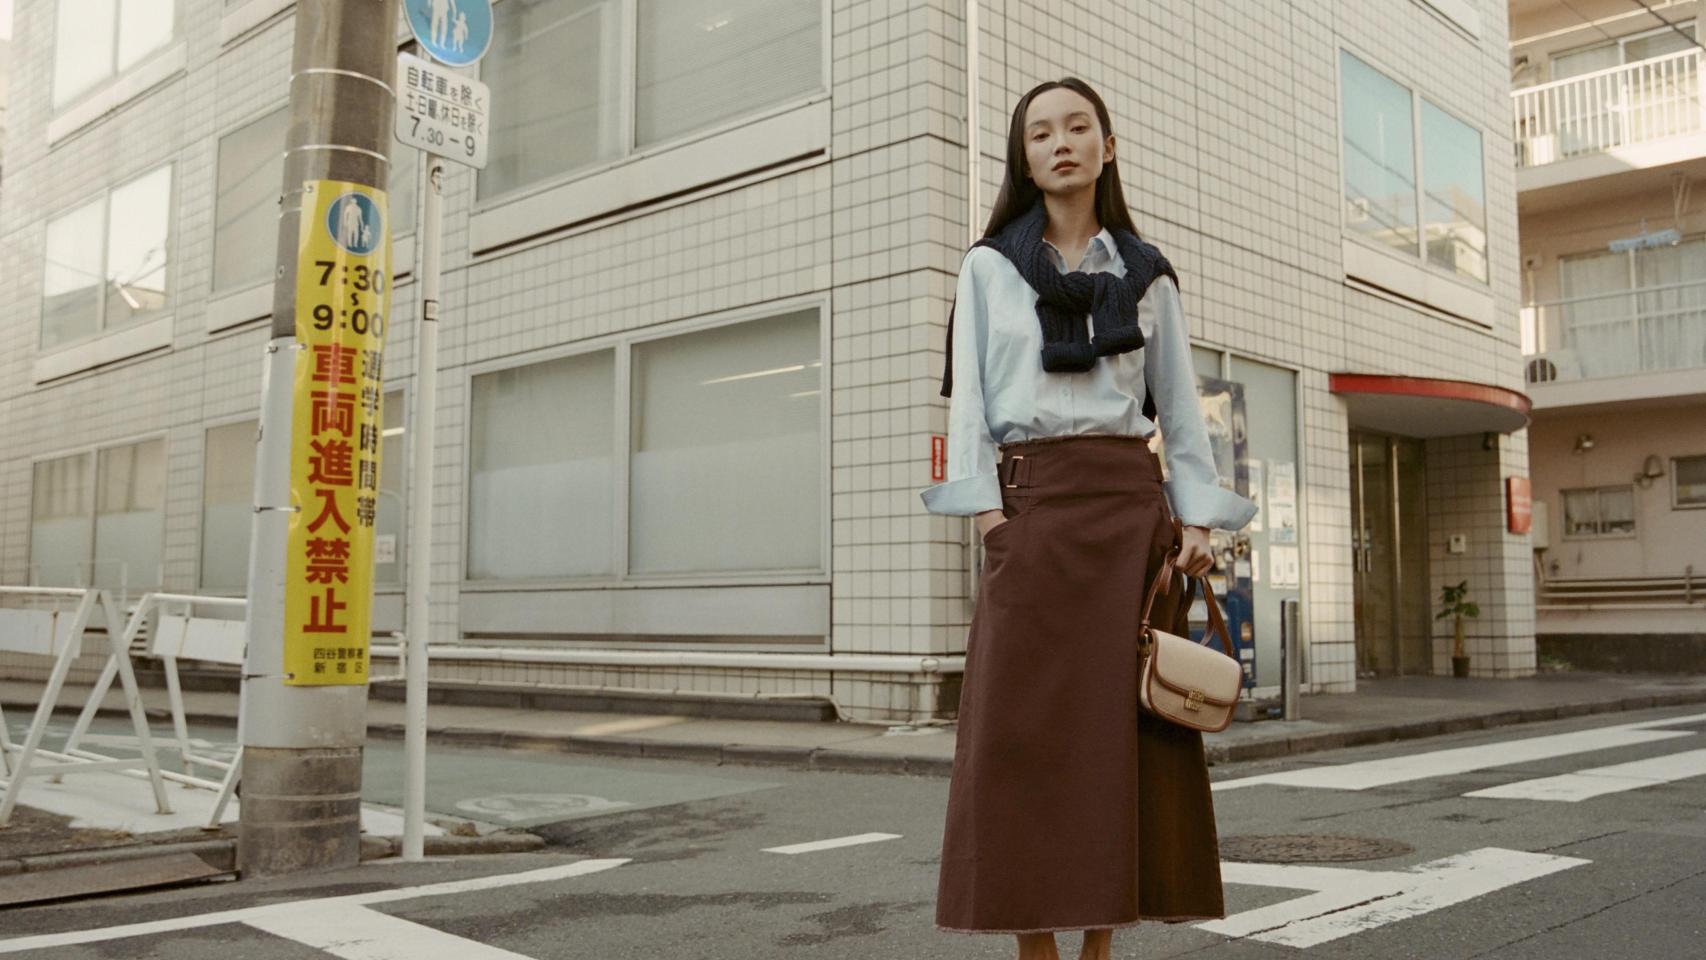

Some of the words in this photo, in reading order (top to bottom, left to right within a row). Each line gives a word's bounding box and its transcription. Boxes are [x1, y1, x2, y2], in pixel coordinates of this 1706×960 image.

[407, 66, 482, 111] 自転車を除く
[315, 260, 384, 295] 7:30
[313, 304, 383, 338] 9:00
[356, 349, 382, 529] 通学時間帯
[302, 343, 357, 634] 車両進入禁止
